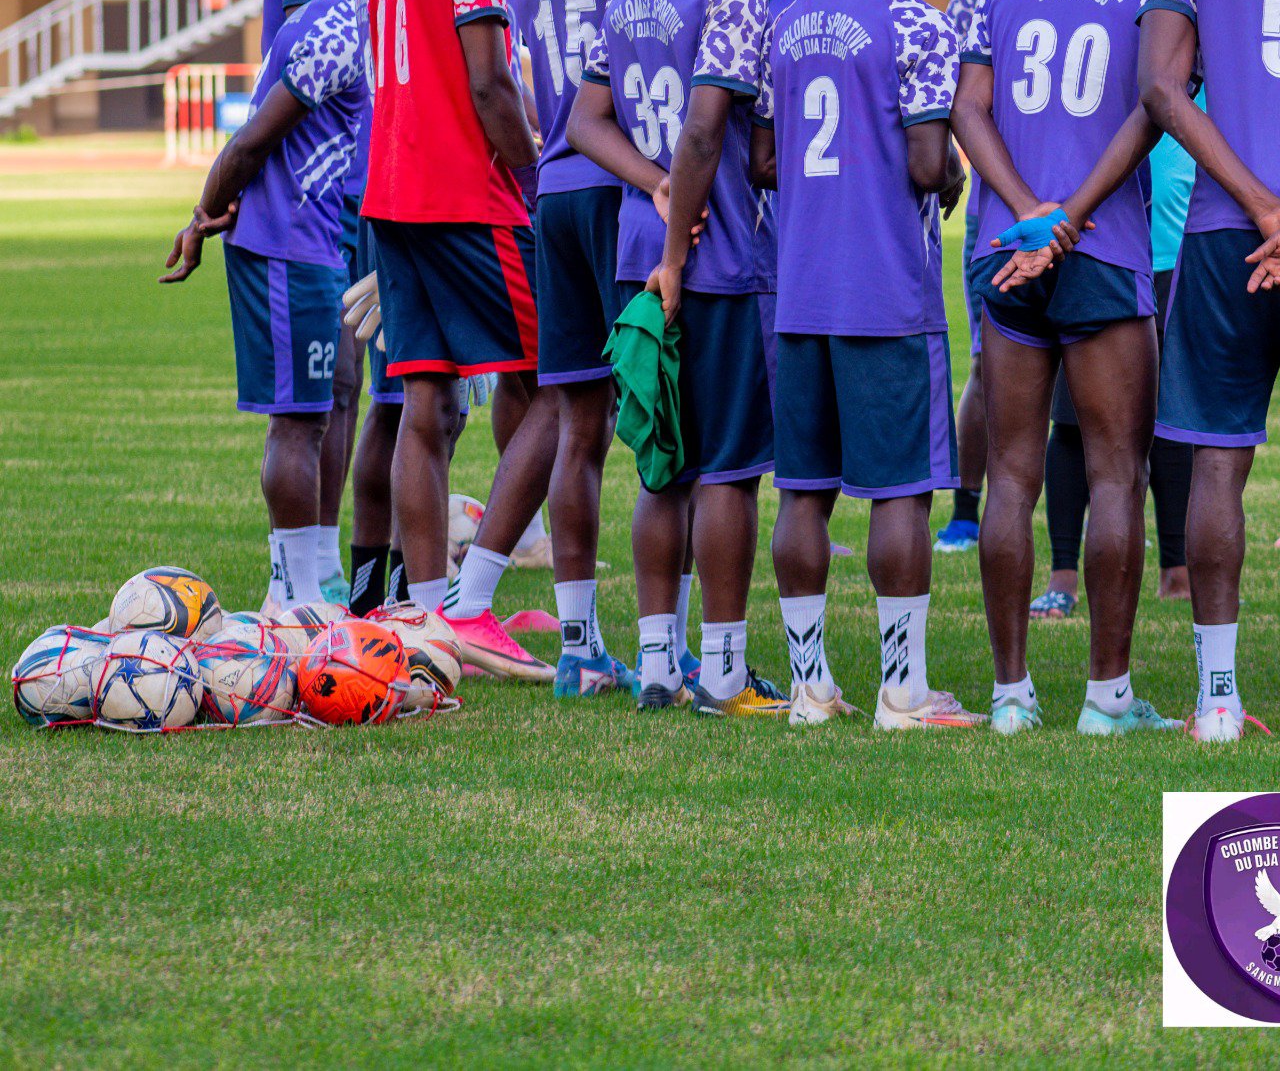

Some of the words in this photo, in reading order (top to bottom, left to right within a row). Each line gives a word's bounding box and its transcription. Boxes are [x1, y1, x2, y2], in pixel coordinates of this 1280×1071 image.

[778, 11, 825, 55] COLOMBE
[826, 12, 872, 57] SPORTIVE
[790, 42, 802, 62] DU
[804, 37, 820, 56] DJA
[821, 37, 831, 54] ET
[831, 39, 849, 61] LOBO
[1011, 18, 1110, 118] 30
[624, 63, 684, 160] 33
[804, 75, 839, 177] 2
[307, 340, 335, 379] 22
[1212, 672, 1233, 696] FS
